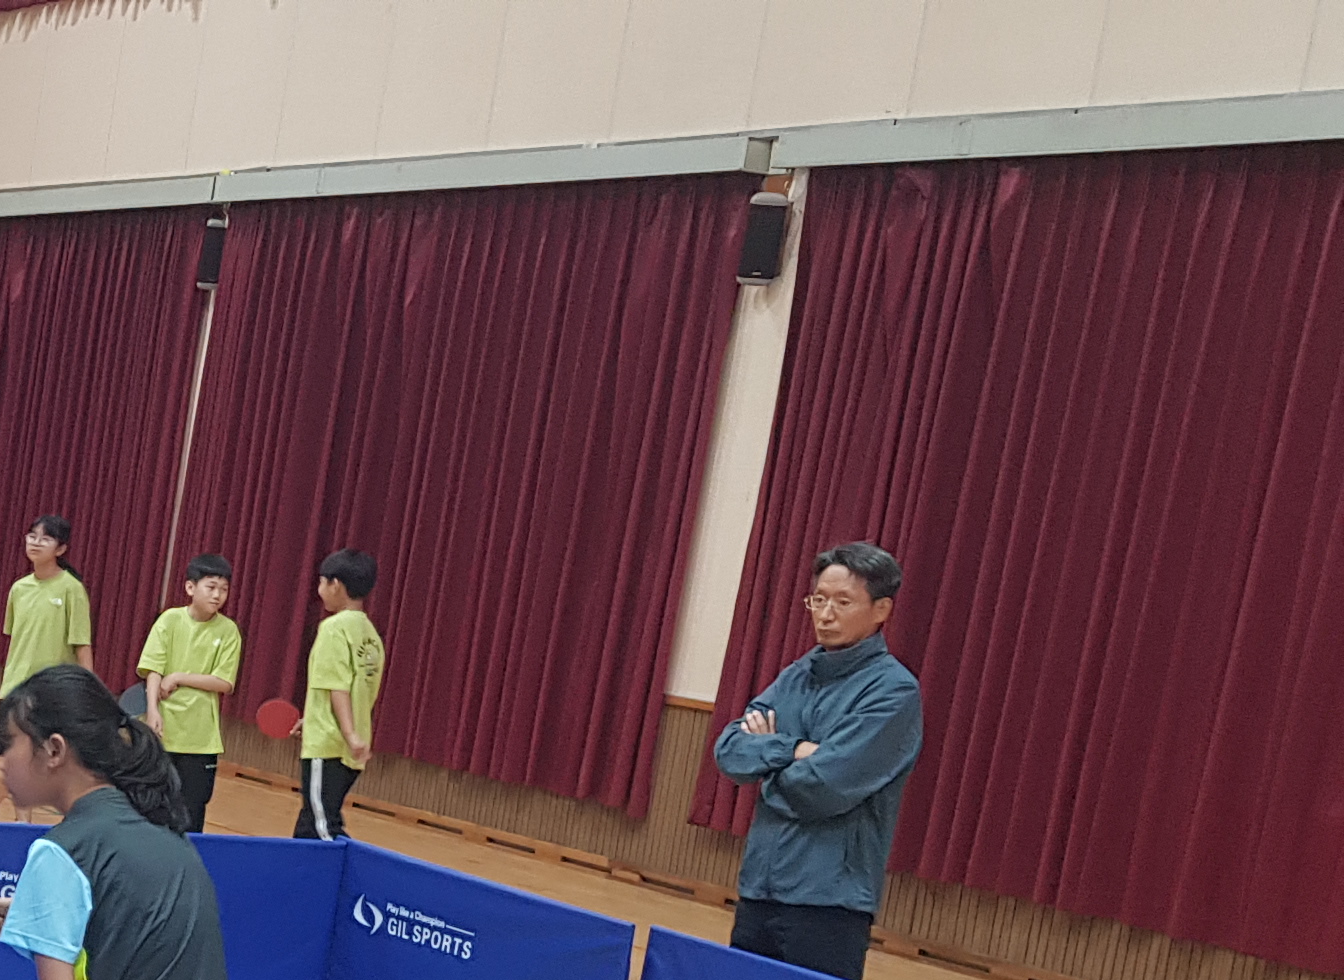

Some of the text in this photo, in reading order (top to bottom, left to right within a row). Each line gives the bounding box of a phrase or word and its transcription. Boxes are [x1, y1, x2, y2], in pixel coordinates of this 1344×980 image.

[0, 870, 19, 883] Play
[387, 917, 472, 960] GIL SPORTS
